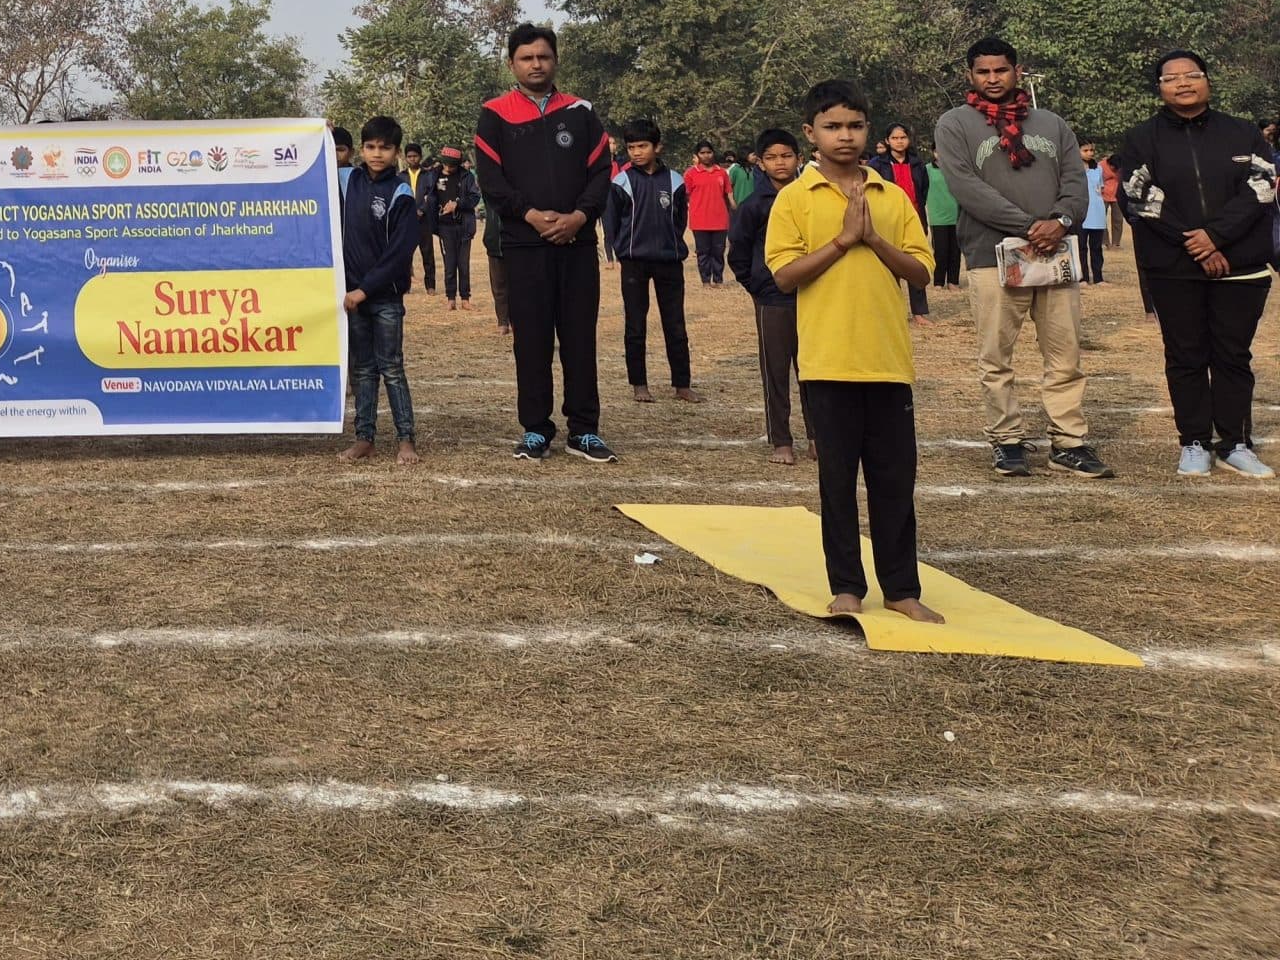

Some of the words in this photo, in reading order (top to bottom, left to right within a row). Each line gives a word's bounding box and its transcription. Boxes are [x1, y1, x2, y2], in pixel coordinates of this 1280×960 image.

[74, 154, 99, 166] INDIA
[138, 165, 162, 174] INDIA
[21, 203, 90, 222] YOGASANA
[91, 203, 132, 220] SPORT
[135, 201, 218, 219] ASSOCIATION
[220, 201, 237, 217] OF
[239, 199, 318, 217] JHARKHAND
[7, 229, 20, 240] to
[22, 227, 82, 242] Yogasana
[85, 225, 118, 240] Sport
[122, 224, 191, 238] Association
[195, 224, 207, 236] of
[210, 222, 274, 237] Jharkhand
[84, 247, 140, 278] Organises
[154, 280, 262, 326] Surya
[116, 317, 304, 355] Namaskar
[143, 380, 205, 393] NAVODAYA
[205, 380, 269, 391] VIDYALAYA
[270, 378, 324, 391] LATEHAR
[10, 406, 25, 417] the
[26, 408, 57, 419] energy
[58, 405, 87, 416] within
